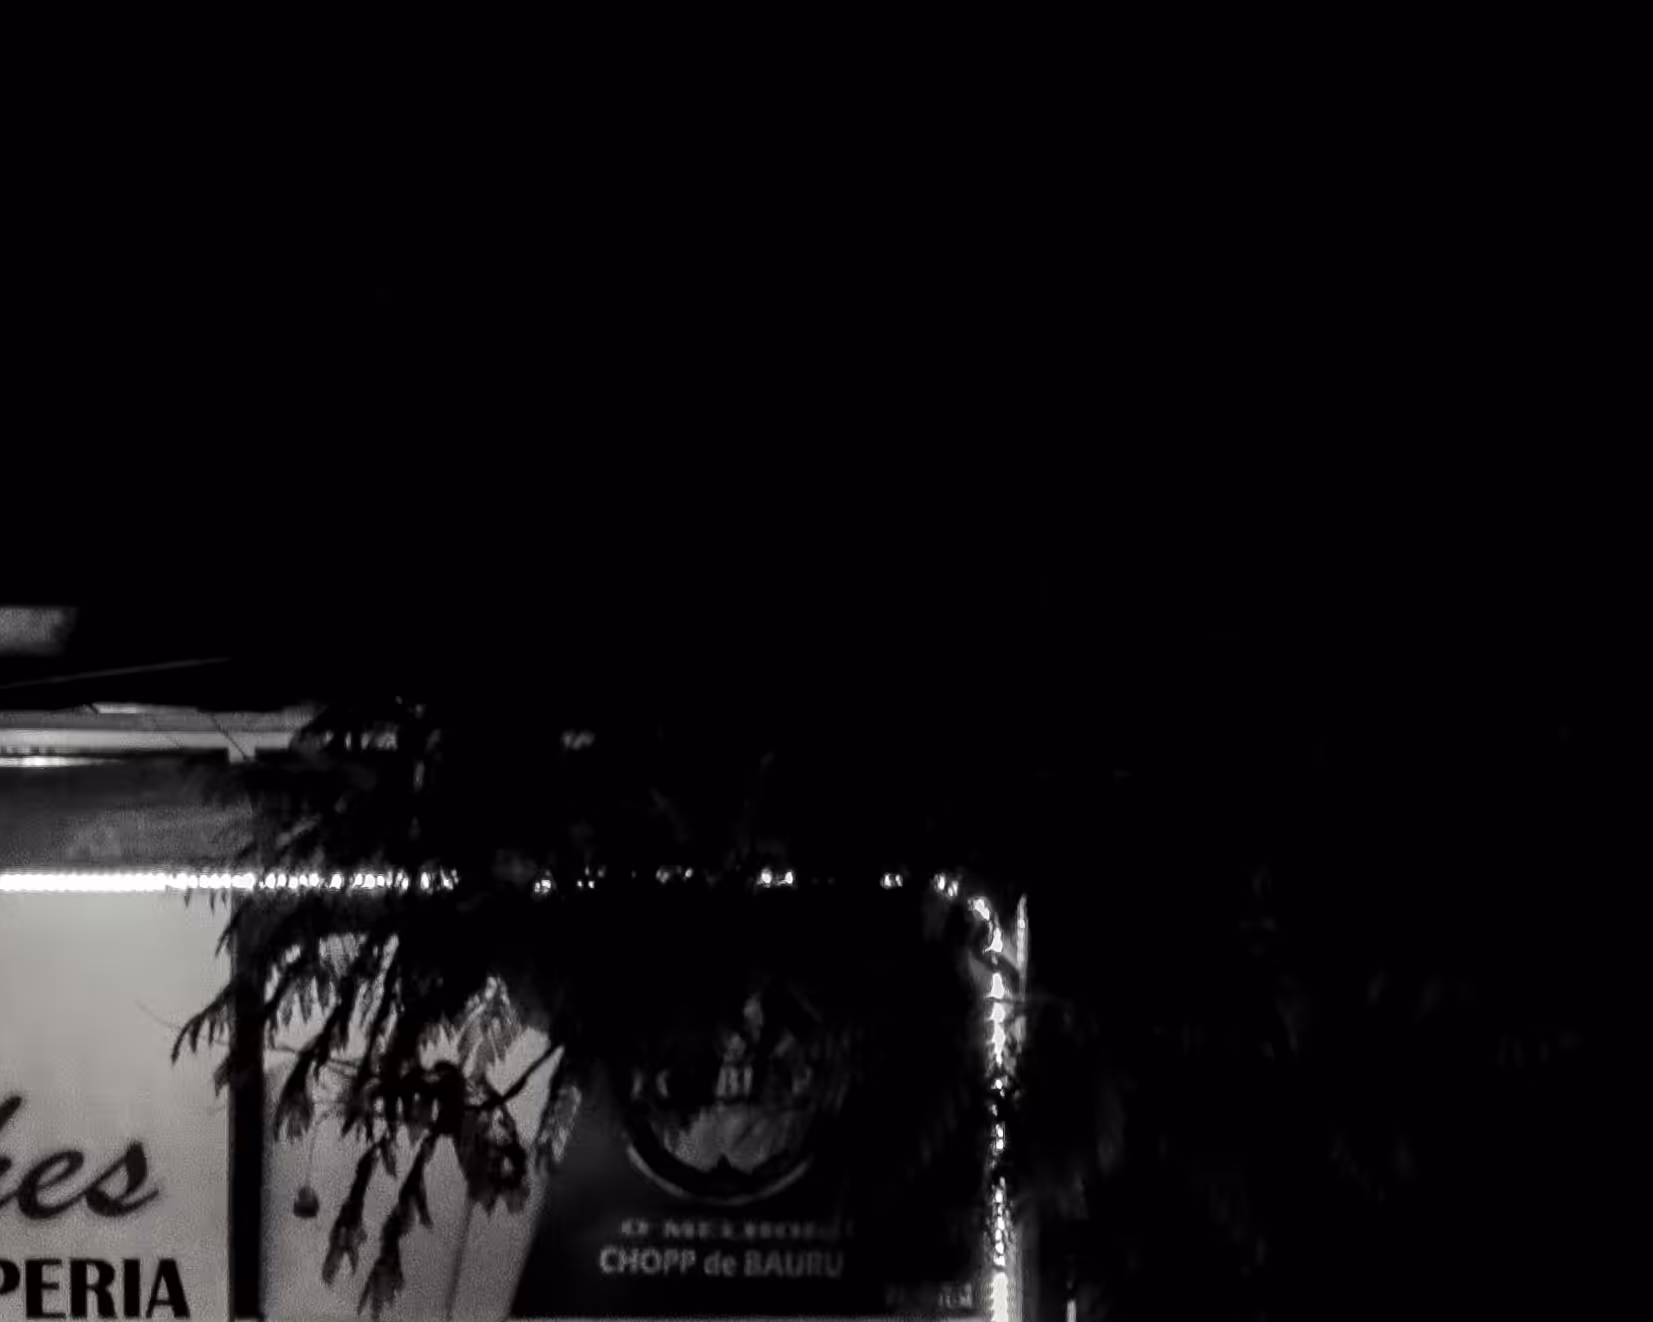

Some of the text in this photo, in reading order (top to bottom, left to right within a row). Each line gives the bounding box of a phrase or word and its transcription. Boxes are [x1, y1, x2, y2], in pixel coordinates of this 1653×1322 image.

[599, 1244, 844, 1279] CHOPP de BAURU
